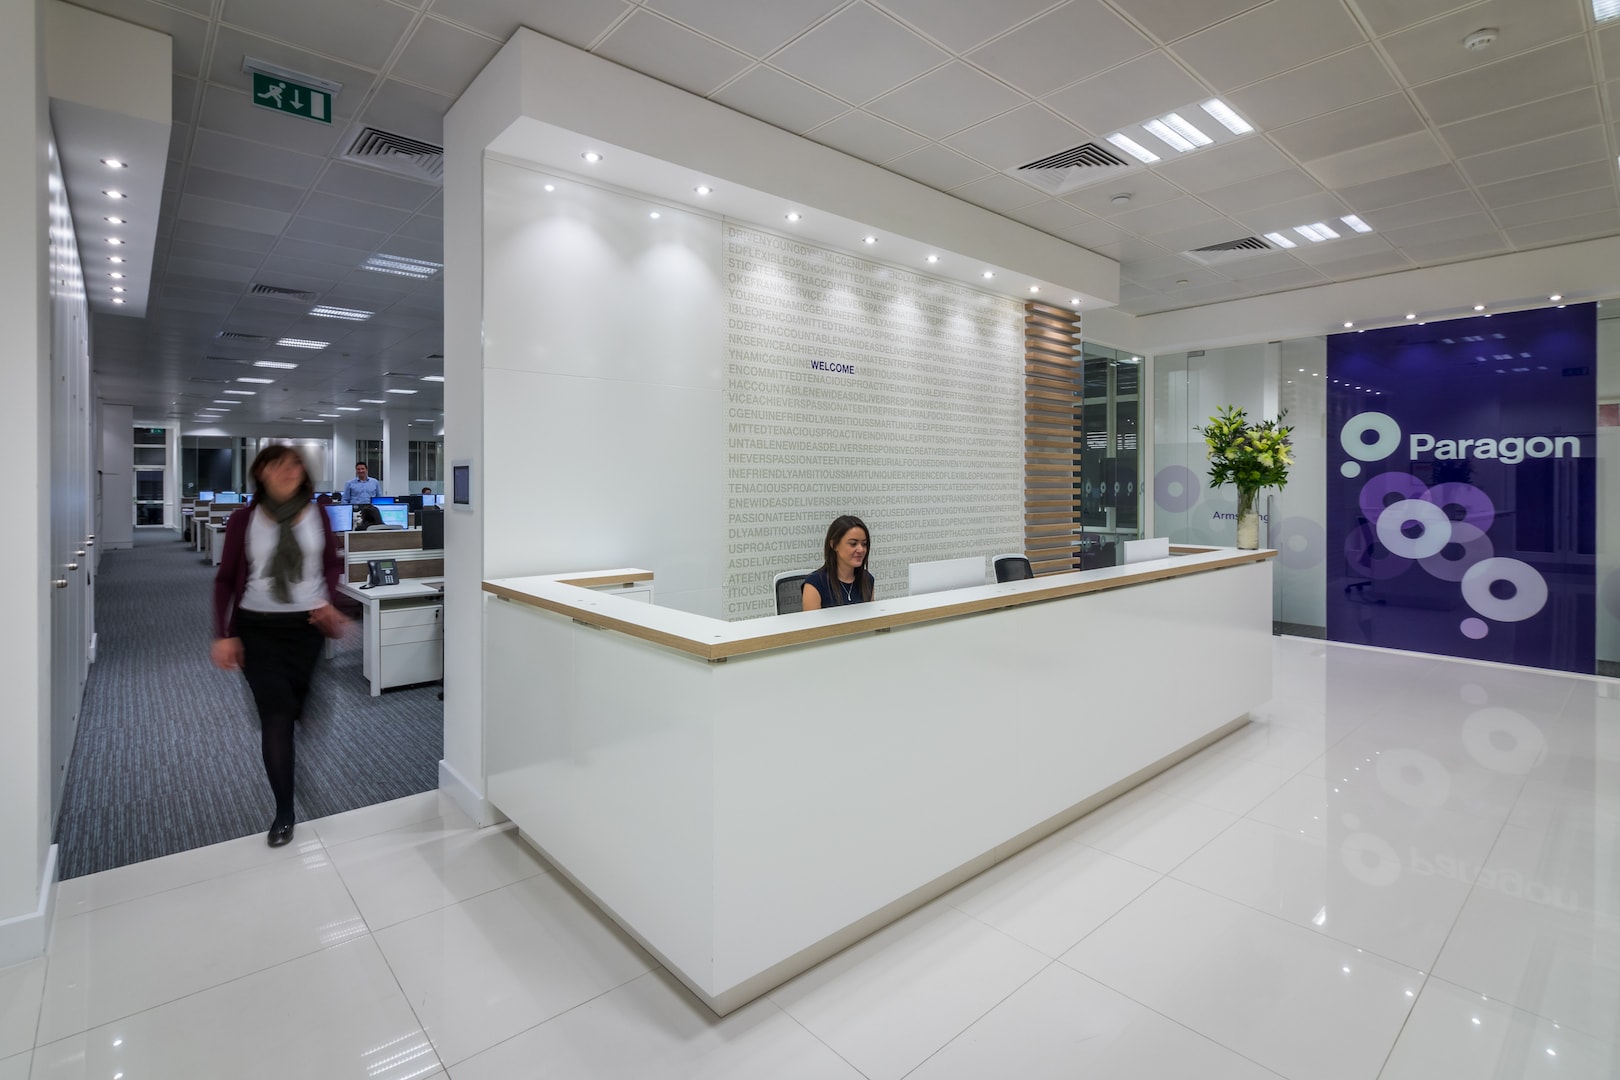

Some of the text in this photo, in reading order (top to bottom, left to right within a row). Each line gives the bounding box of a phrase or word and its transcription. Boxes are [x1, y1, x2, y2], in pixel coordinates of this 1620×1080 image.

[810, 359, 855, 375] WELCOME
[1409, 433, 1581, 465] Paragon
[1212, 511, 1270, 524] Armsng
